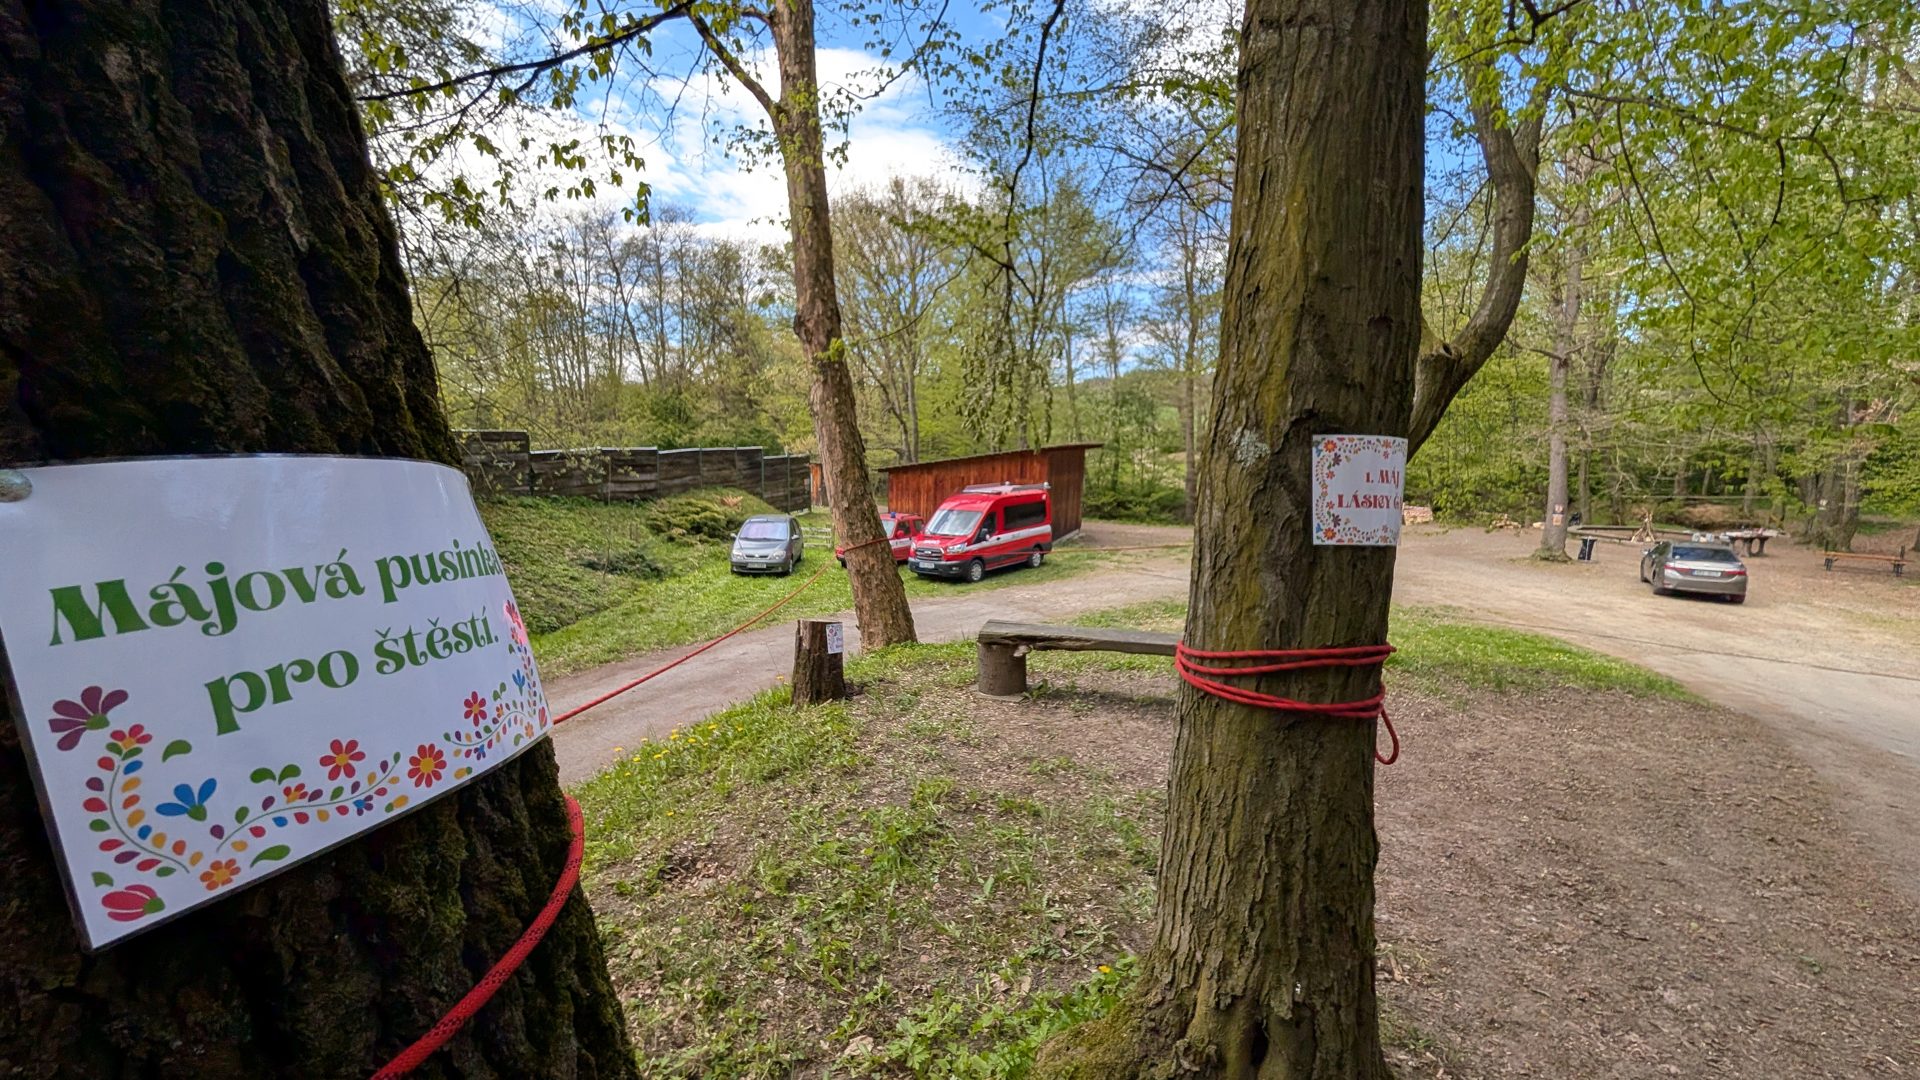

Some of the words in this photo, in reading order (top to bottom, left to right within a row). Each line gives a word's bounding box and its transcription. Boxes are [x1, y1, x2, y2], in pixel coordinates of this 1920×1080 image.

[1337, 490, 1392, 509] LÁSKY
[48, 548, 365, 647] Májová
[203, 649, 359, 736] pro
[373, 605, 499, 676] štěstí.
